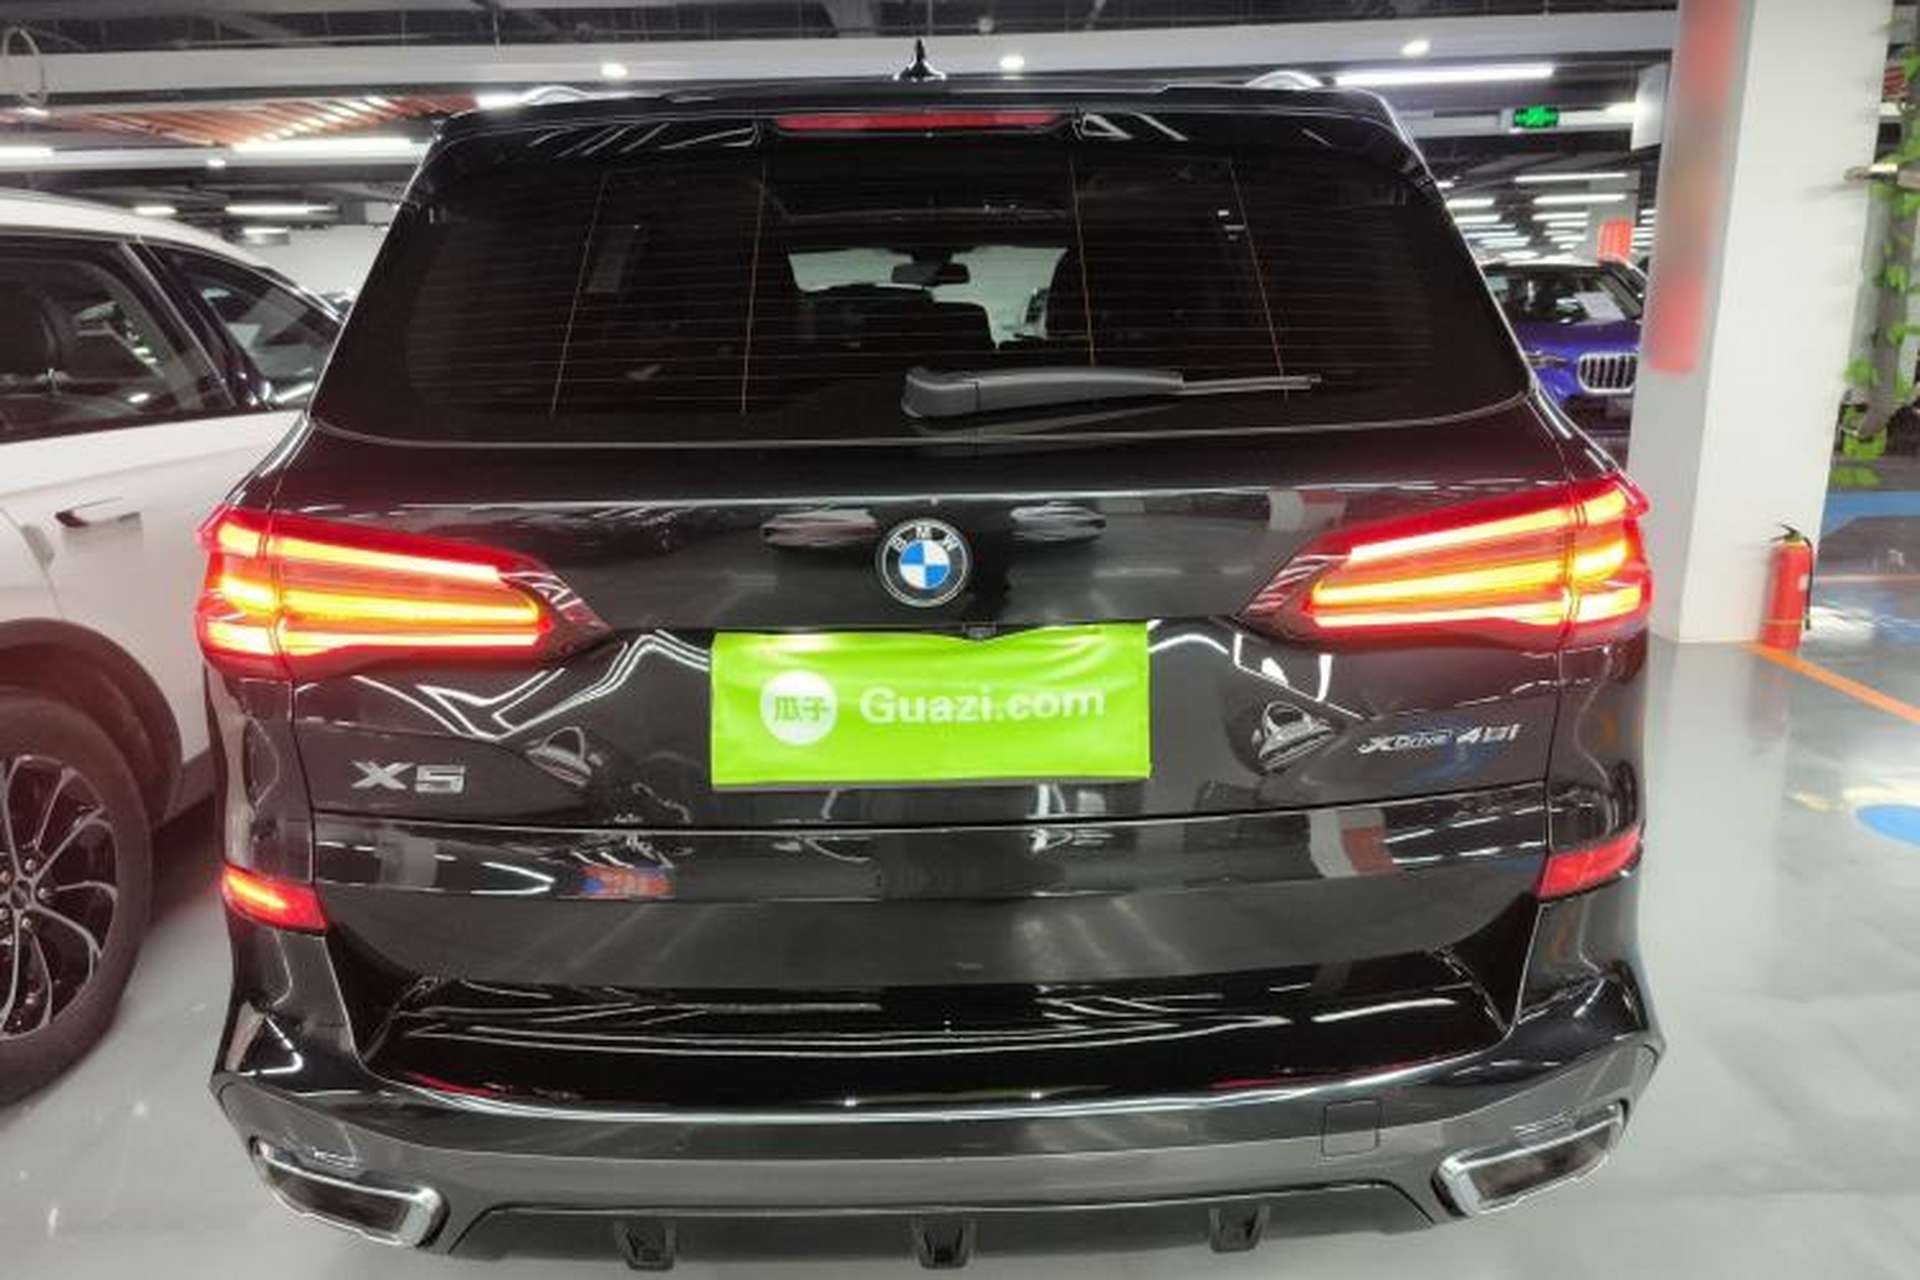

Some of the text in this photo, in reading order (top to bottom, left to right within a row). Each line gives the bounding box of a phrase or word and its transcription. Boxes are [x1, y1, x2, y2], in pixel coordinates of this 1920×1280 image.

[773, 695, 832, 722] 瓜子
[859, 685, 1105, 725] Guazi.com
[350, 761, 465, 793] X5
